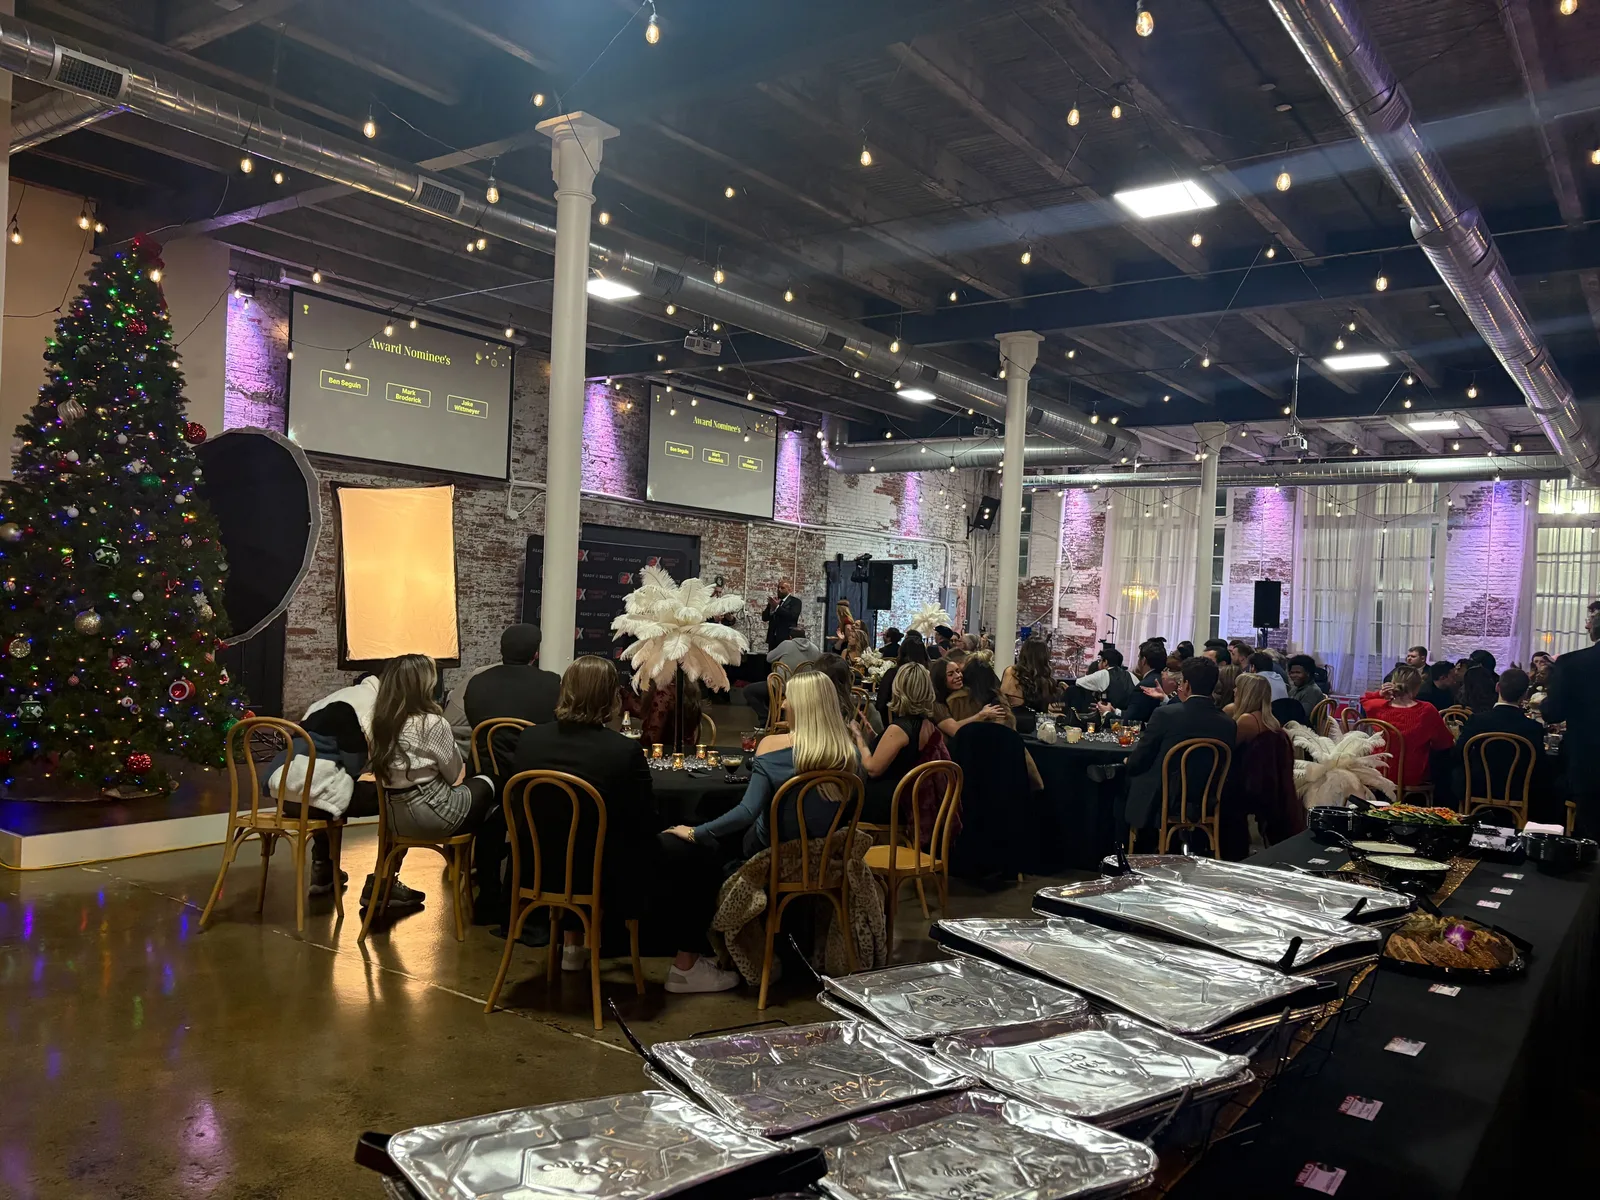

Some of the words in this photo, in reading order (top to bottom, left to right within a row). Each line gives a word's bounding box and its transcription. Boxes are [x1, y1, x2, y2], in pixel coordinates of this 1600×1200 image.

[369, 338, 402, 355] Award
[403, 345, 451, 366] Nominee's
[328, 376, 341, 385] Ben
[341, 379, 362, 389] Seguin
[401, 387, 416, 396] Mark
[395, 394, 422, 404] Broderick
[461, 399, 474, 408] Jake
[453, 404, 480, 415] Wittmeyer
[693, 416, 712, 427] Award
[713, 420, 741, 433] Nominee's
